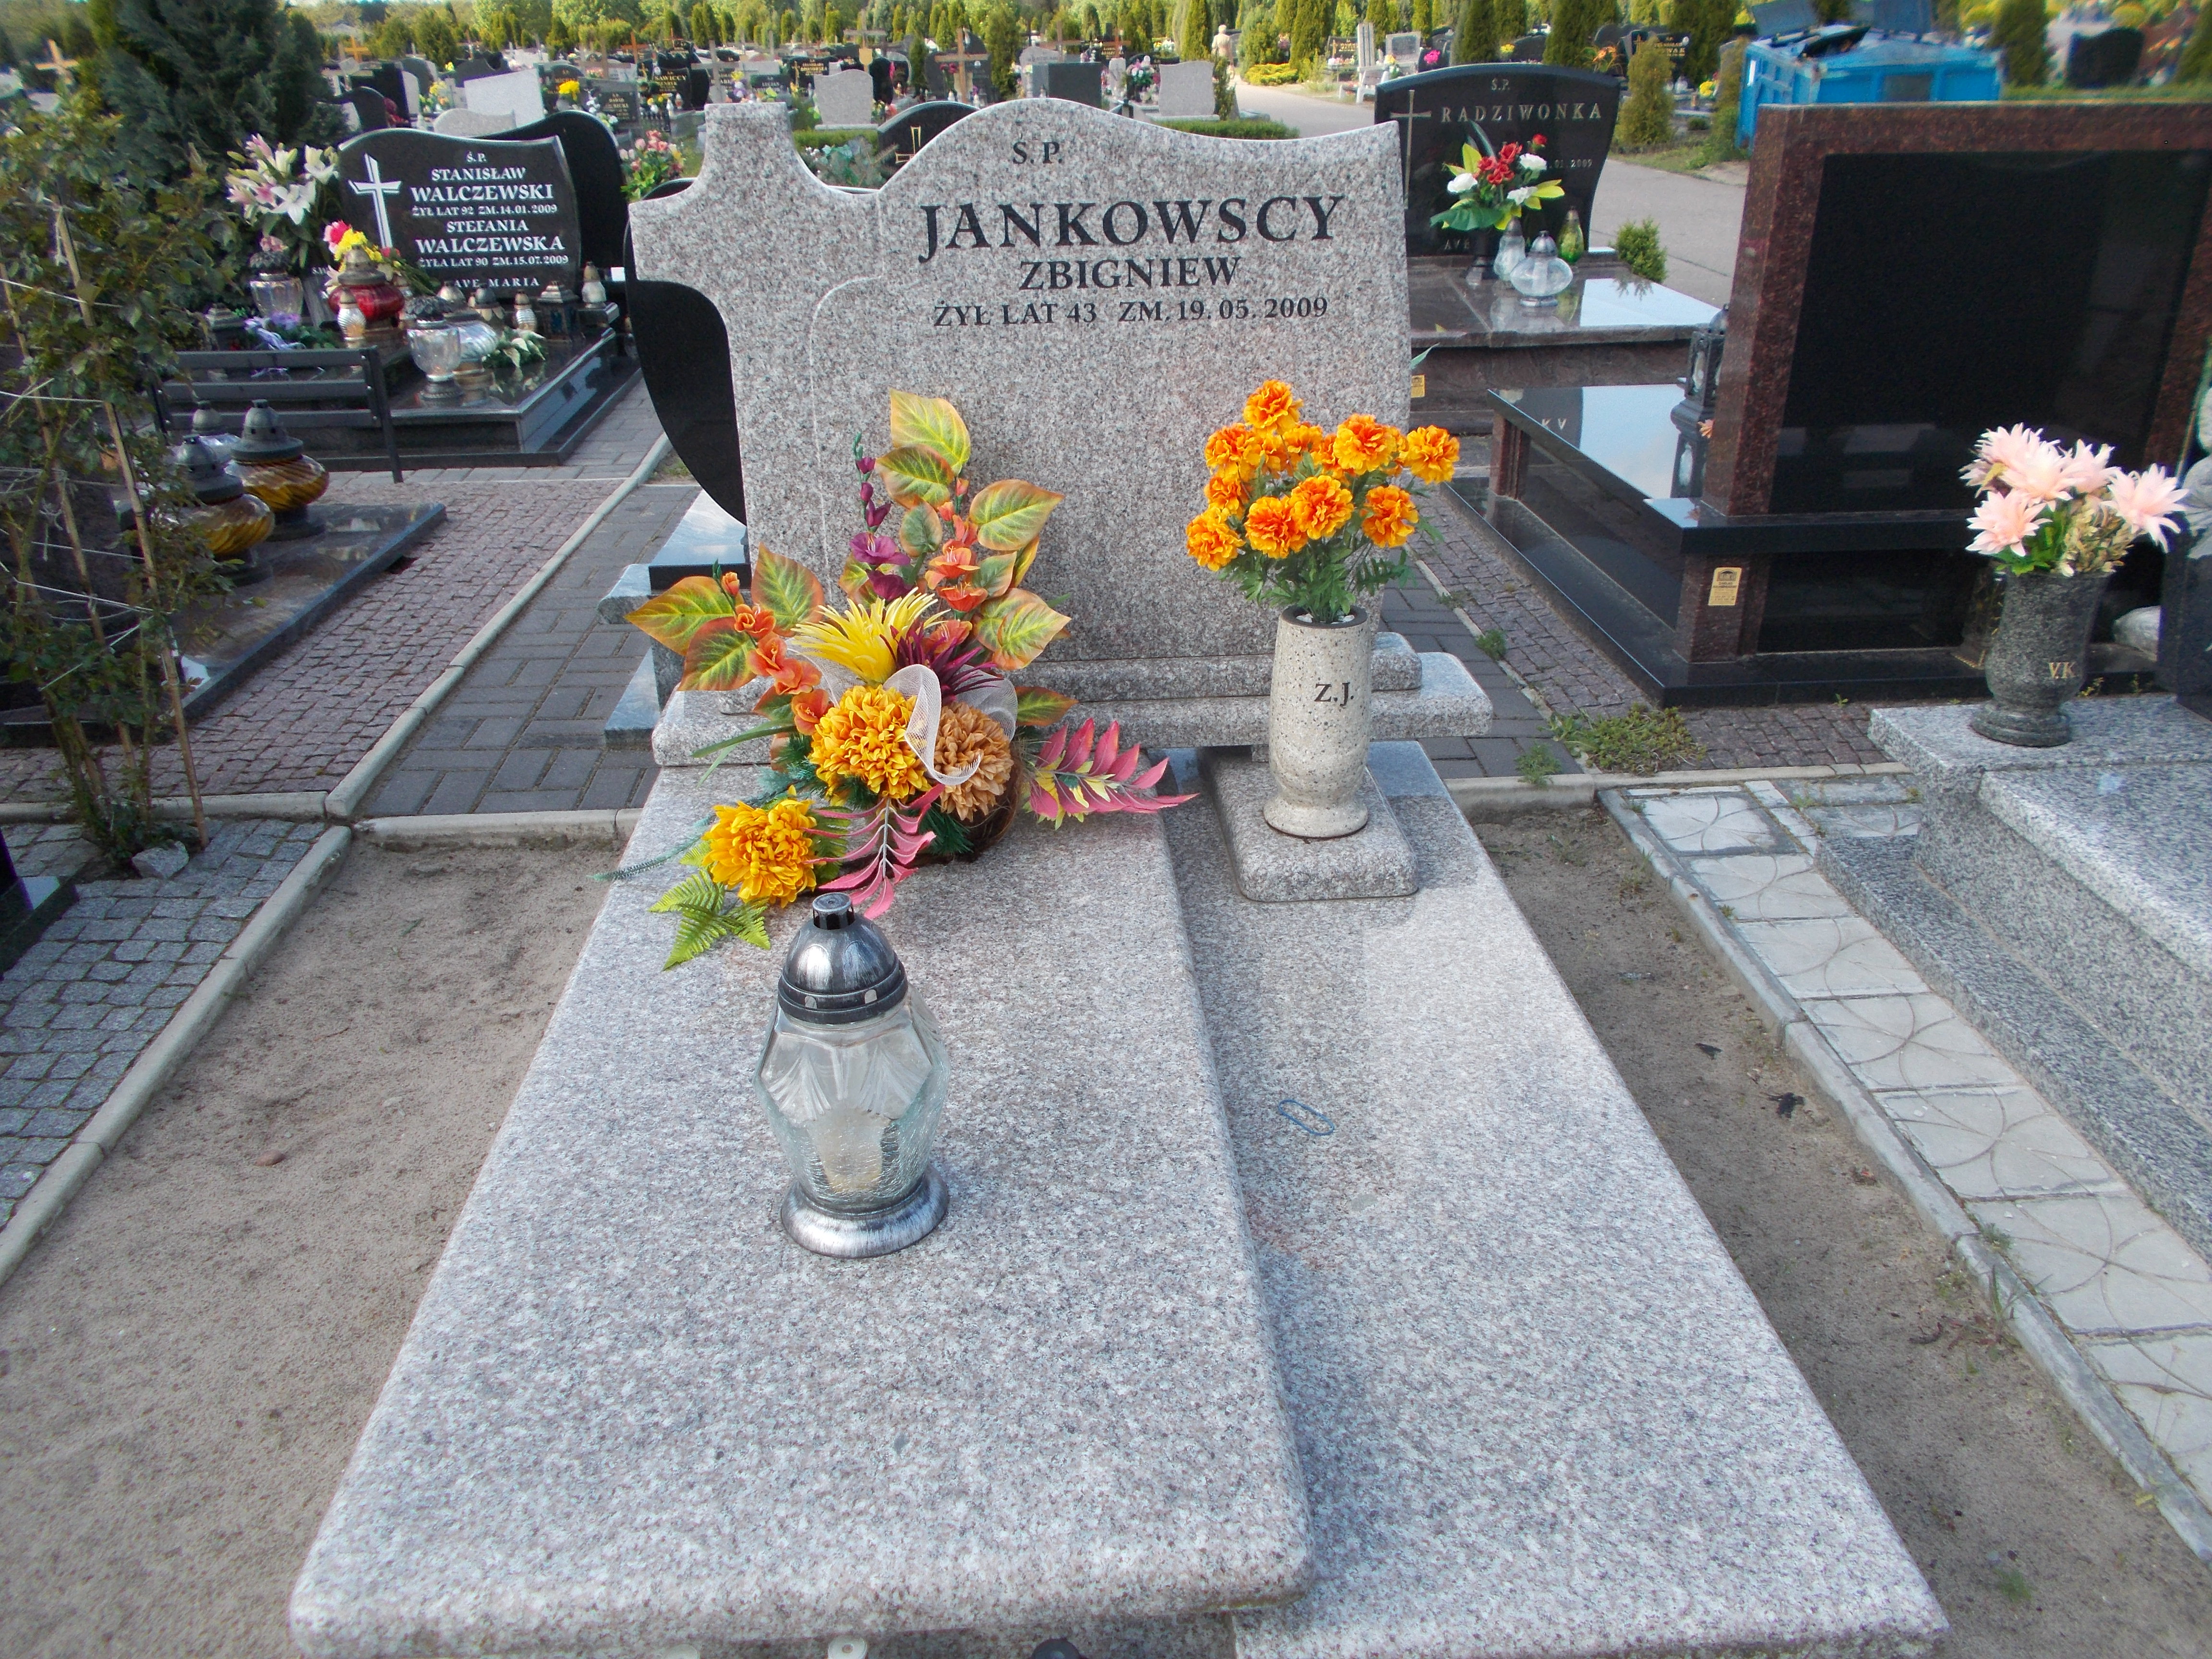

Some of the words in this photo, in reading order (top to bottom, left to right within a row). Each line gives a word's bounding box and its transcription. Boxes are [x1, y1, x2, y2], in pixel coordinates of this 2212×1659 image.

[1441, 102, 1601, 122] RADZIWONKA
[431, 167, 527, 181] STANISŁAW
[410, 183, 554, 202] WALCZEWSKI
[411, 206, 434, 217] ŻYŁ
[436, 206, 460, 216] LAT
[461, 205, 474, 216] 92
[446, 219, 529, 233] STEFANIA
[918, 195, 1344, 264] JANKOWSCY
[415, 235, 566, 254] WALCZEWSKA
[451, 257, 473, 267] LAT
[475, 256, 489, 266] 90
[1019, 256, 1242, 290] ZBIGNIEW
[454, 278, 480, 289] AVE
[487, 277, 541, 288] MARIA
[933, 300, 991, 327] ŻYŁ
[1001, 303, 1058, 325] LAT
[1066, 302, 1098, 324] 43
